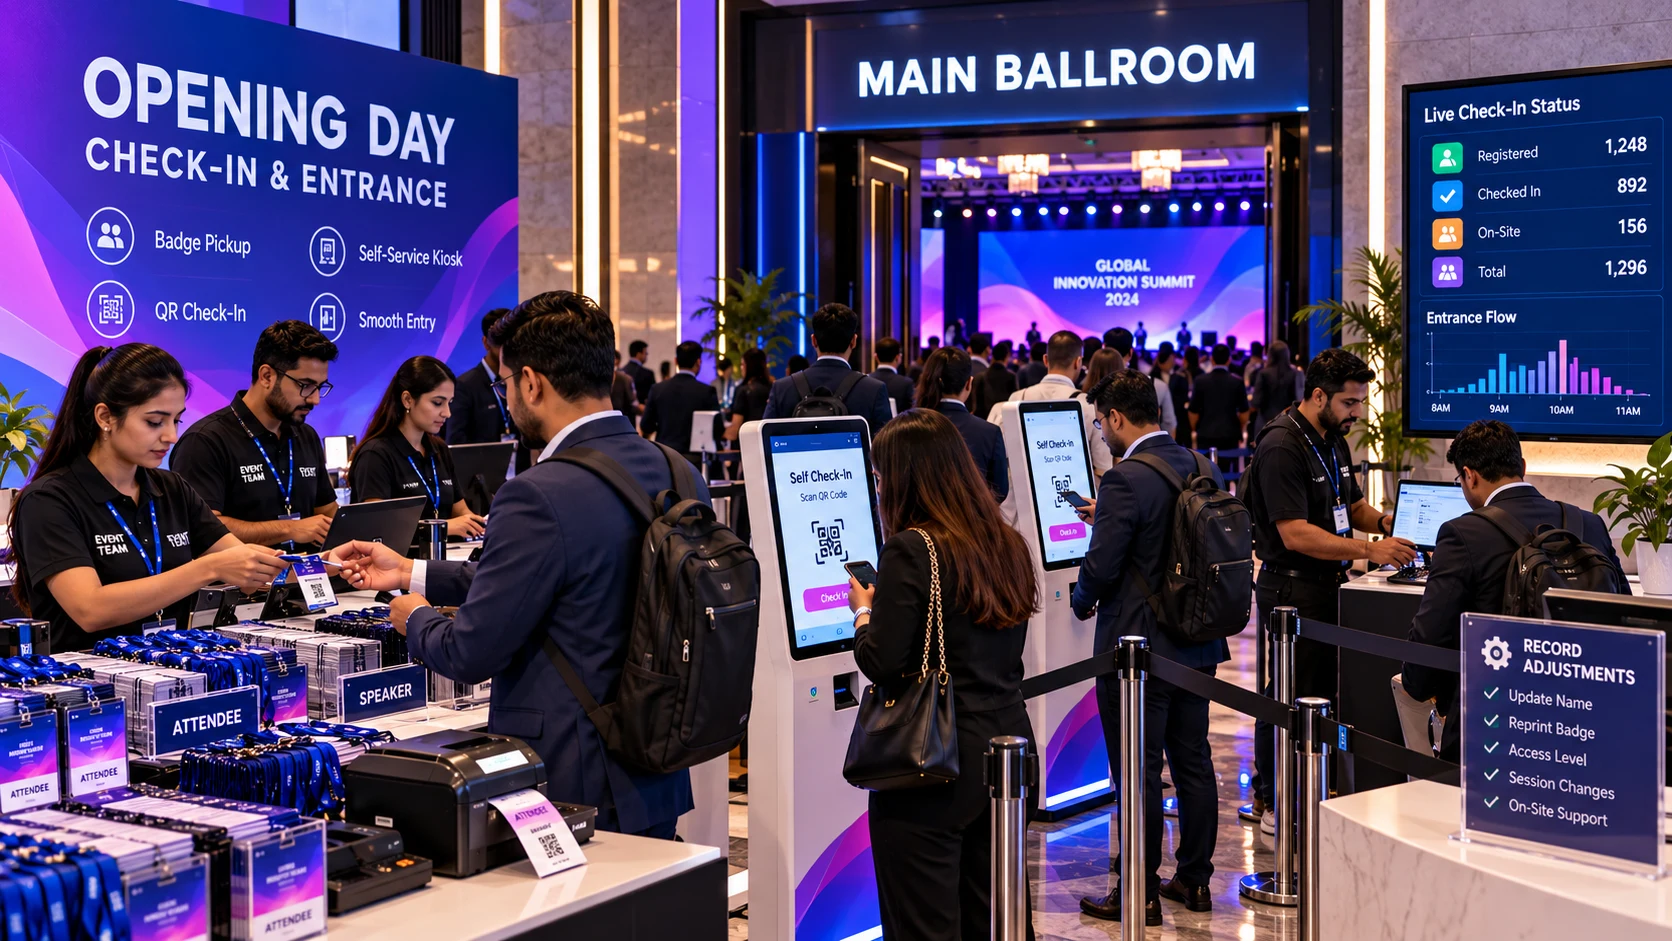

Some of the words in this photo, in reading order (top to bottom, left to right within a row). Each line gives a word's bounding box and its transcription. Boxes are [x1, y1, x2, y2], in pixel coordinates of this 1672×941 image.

[858, 55, 977, 98] MAIN
[995, 42, 1255, 91] BALLROOM
[83, 56, 348, 151] OPENING
[369, 103, 455, 166] DAY
[1424, 107, 1455, 123] Live
[1458, 100, 1527, 120] Check-In
[1530, 97, 1581, 115] Status
[1477, 145, 1539, 164] Registered
[1605, 136, 1648, 156] 1,248
[85, 137, 258, 188] CHECK-IN
[269, 160, 290, 191] &
[302, 163, 447, 208] ENTRANCE
[1477, 185, 1527, 200] Checked
[1530, 185, 1541, 197] In
[1617, 176, 1648, 193] 892
[1477, 225, 1521, 239] On-Site
[1618, 217, 1648, 234] 156
[154, 230, 201, 255] Badge
[205, 234, 252, 260] Pickup
[358, 244, 430, 266] Self-Service
[432, 249, 463, 268] Kiosk
[1095, 258, 1151, 273] GLOBAL
[1478, 265, 1506, 278] Total
[1605, 259, 1648, 278] 1,296
[1053, 275, 1138, 290] INNOVATION
[1141, 274, 1195, 289] SUMMIT
[1105, 293, 1139, 307] 2024
[154, 301, 178, 322] QR
[182, 301, 247, 323] Check-In
[358, 310, 404, 330] Smooth
[406, 312, 436, 333] Entry
[1426, 311, 1483, 325] Entrance
[1485, 310, 1517, 324] Flow
[1431, 403, 1451, 413] 8AM
[1489, 404, 1509, 414] 9AM
[1549, 405, 1574, 415] 10AM
[1616, 406, 1641, 416] 11AM
[241, 472, 266, 484] TEAM
[789, 470, 809, 485] Self
[810, 468, 852, 483] Check-In
[800, 492, 817, 503] Scan
[818, 491, 829, 502] QR
[829, 490, 848, 501] Code
[97, 543, 129, 557] TEAM
[1523, 638, 1583, 658] RECORD
[1523, 659, 1636, 685] ADJUSTMENTS
[359, 682, 413, 706] SPEAKER
[1508, 688, 1553, 706] Update
[1556, 694, 1593, 711] Name
[172, 708, 242, 736] ATTENDEE
[1508, 716, 1553, 734] Reprint
[1556, 722, 1596, 742] Badge
[1508, 743, 1551, 761] Access
[1555, 749, 1587, 767] Level
[80, 766, 119, 783] ATTENDEE
[10, 782, 50, 800] ATTENDEE
[1508, 771, 1556, 790] Session
[1559, 778, 1616, 800] Changes
[1508, 798, 1554, 818] On-Site
[1557, 806, 1608, 827] Support
[265, 908, 313, 934] ATTENDEE
